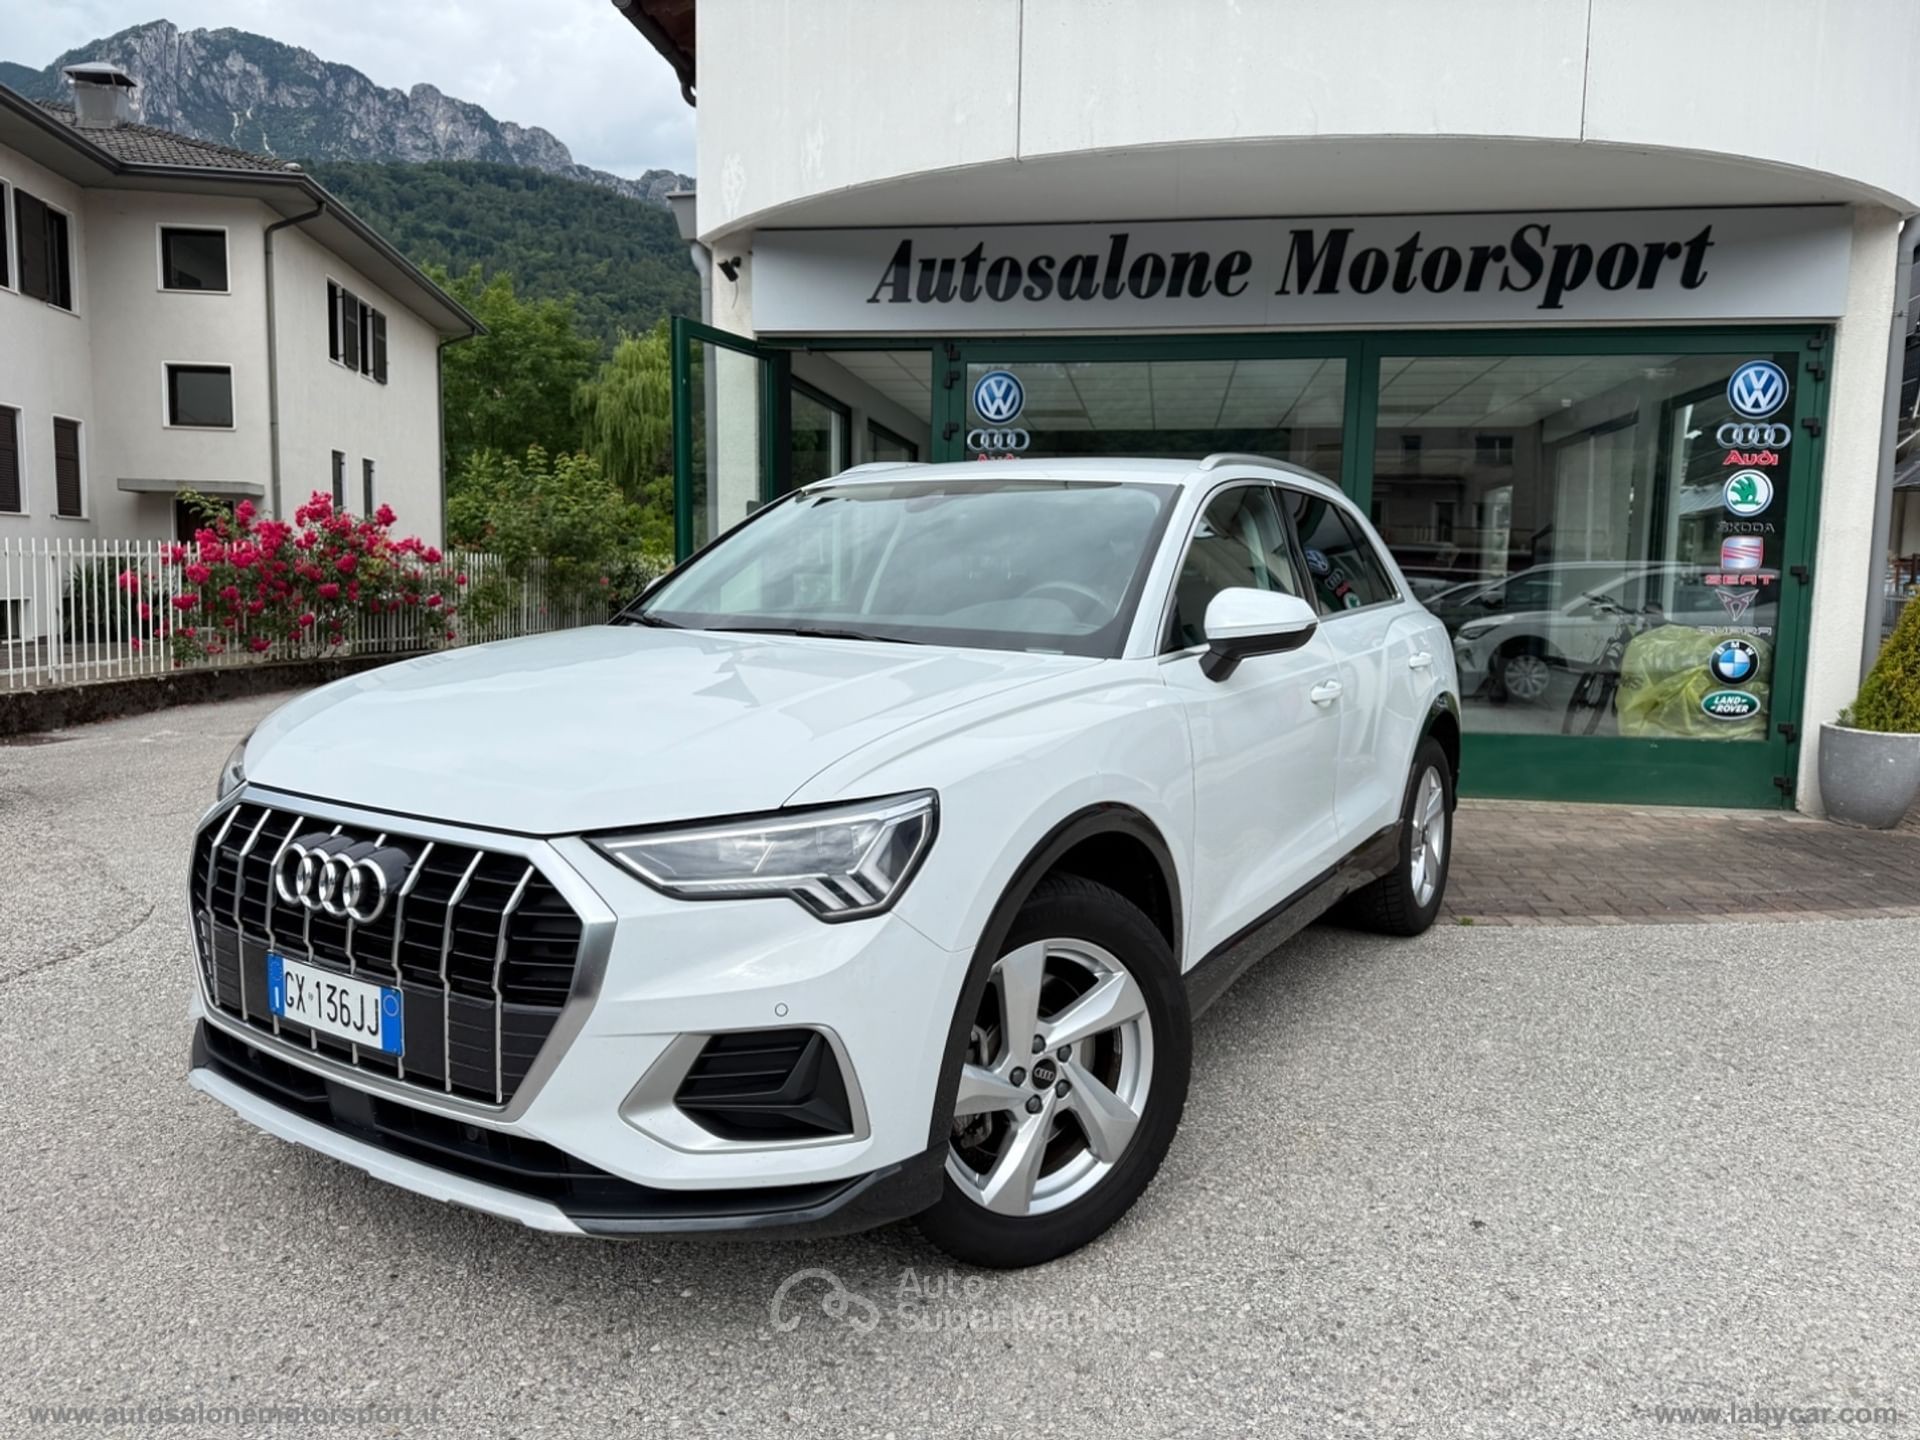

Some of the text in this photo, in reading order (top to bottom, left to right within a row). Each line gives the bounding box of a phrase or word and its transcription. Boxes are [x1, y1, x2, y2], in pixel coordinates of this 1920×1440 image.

[867, 223, 1715, 310] Autosalone MotorSport
[1722, 450, 1779, 466] Audi
[1704, 574, 1775, 586] SEAT
[1716, 640, 1755, 656] BMW
